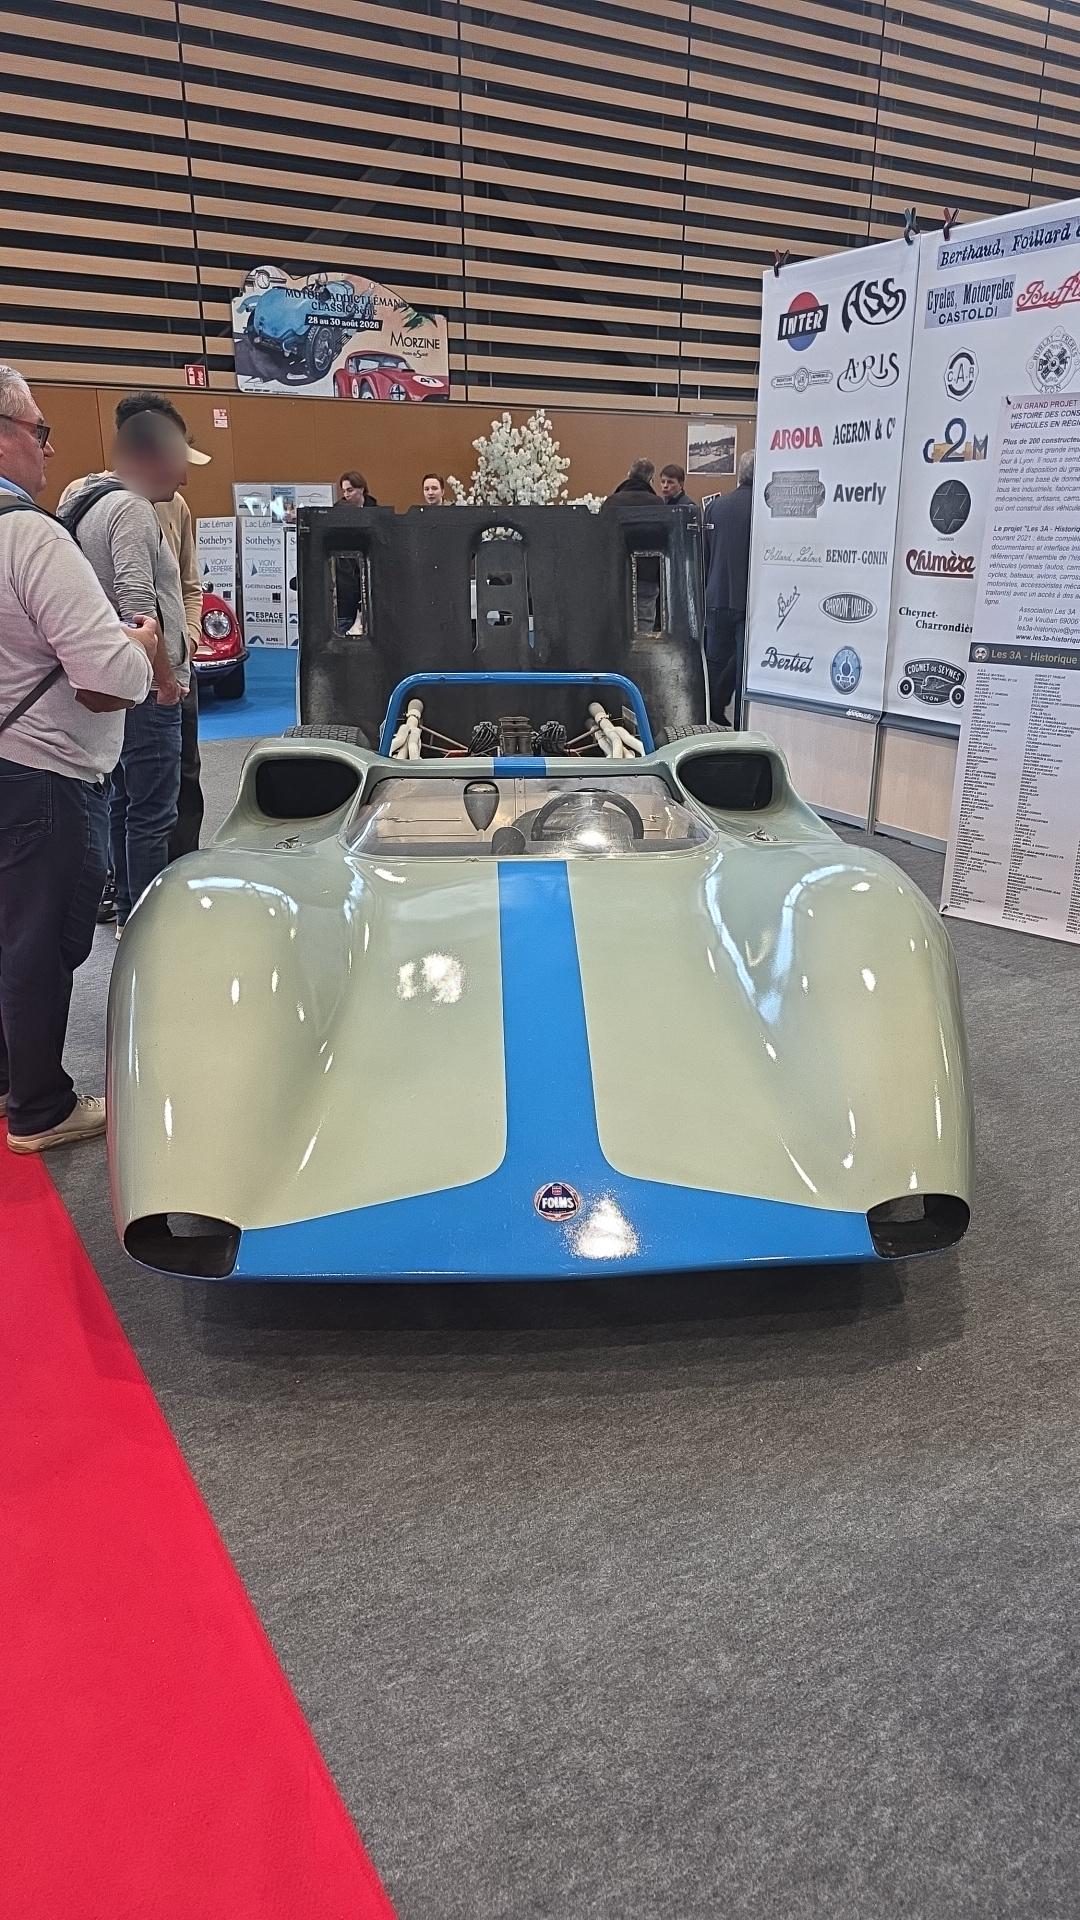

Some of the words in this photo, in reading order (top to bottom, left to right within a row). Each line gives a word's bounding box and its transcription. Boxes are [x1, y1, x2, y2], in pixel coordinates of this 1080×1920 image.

[940, 238, 1005, 267] Berthaud,
[1012, 222, 1071, 252] Foillard
[927, 287, 958, 315] Cycles,
[963, 278, 1014, 305] Motocycles
[311, 301, 352, 313] CLASSIC
[841, 277, 907, 333] ASS
[938, 306, 998, 325] CASTOLDI
[307, 316, 319, 324] 28
[329, 318, 341, 326] 30
[341, 319, 359, 328] août
[360, 320, 380, 329] 2026
[781, 309, 824, 336] INTER
[390, 331, 440, 349] MORZINE
[1012, 402, 1022, 410] UN
[1024, 401, 1048, 409] GRAND
[1050, 399, 1078, 408] PROJET
[1011, 411, 1043, 420] HISTOIRE
[1045, 410, 1059, 418] DES
[1010, 420, 1048, 430] VÉHICULES
[832, 419, 872, 446] AGERON
[875, 417, 882, 441] &
[770, 425, 823, 451] AROLA
[1029, 437, 1040, 445] 200
[1001, 448, 1014, 456] plus
[1045, 447, 1066, 455] grande
[1026, 466, 1057, 474] disposition
[833, 482, 887, 506] Averly
[200, 520, 210, 529] Lac
[212, 520, 233, 528] Léman
[245, 520, 257, 528] Lac
[1003, 525, 1022, 533] projet
[199, 535, 233, 546] Sotheby's
[245, 535, 281, 547] Sotheby's
[905, 549, 976, 577] Chimère
[255, 611, 284, 619] ESPACE
[1018, 606, 1054, 615] Association
[1054, 607, 1066, 615] Les
[1067, 608, 1076, 616] 3A
[1035, 616, 1058, 624] Vauban
[991, 649, 1008, 659] Les
[1010, 649, 1022, 660] 3A
[1030, 651, 1078, 665] Historique
[907, 662, 930, 675] COGNET
[938, 664, 962, 682] SEYNES
[922, 694, 939, 702] LYON
